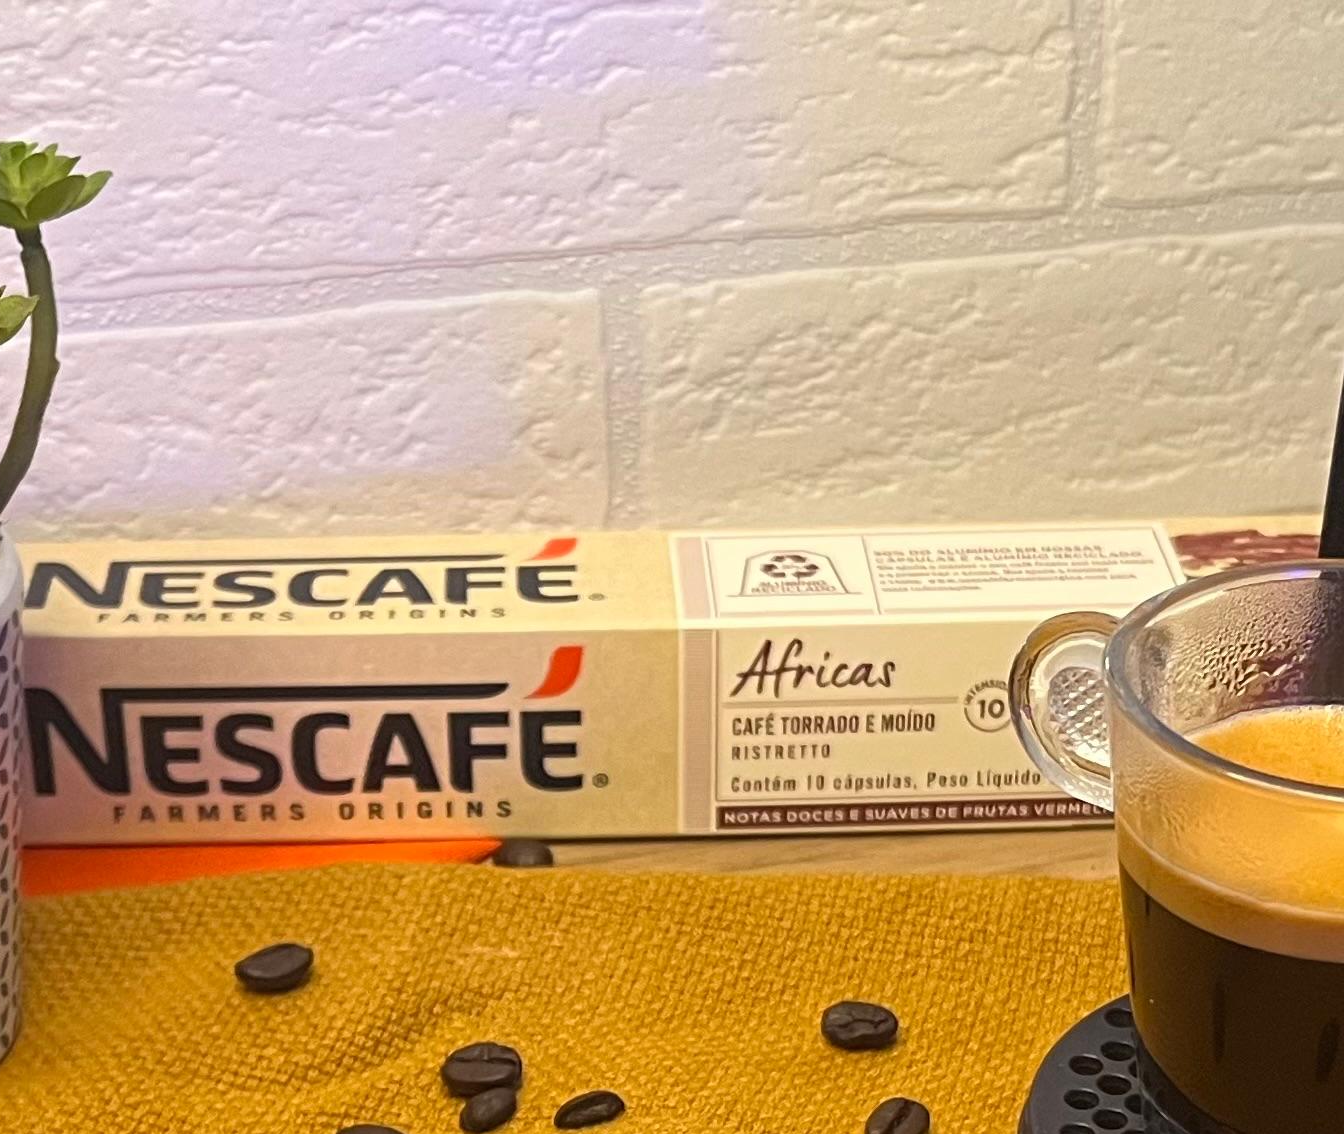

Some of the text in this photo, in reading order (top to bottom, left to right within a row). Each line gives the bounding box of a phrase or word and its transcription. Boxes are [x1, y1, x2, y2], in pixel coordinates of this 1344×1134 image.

[24, 537, 579, 609] NESCAFÉ
[97, 608, 506, 624] FARMERS ORIGINS
[729, 638, 896, 698] Africas
[964, 679, 1008, 705] INTENSID
[24, 645, 584, 796] NESCAFÉ
[978, 699, 1005, 719] 10
[732, 709, 936, 736] CAFÉ TORRADO E MOÍDO
[731, 743, 831, 761] RISTRETTO
[731, 776, 797, 793] Contém
[807, 774, 825, 791] 10
[927, 771, 968, 788] Peso
[977, 769, 1041, 791] Líquido
[112, 801, 512, 824] FARMERS ORIGINS
[724, 802, 1108, 824] NOTAS DOCES E SUAVES DE FRUTAS VERMEL
